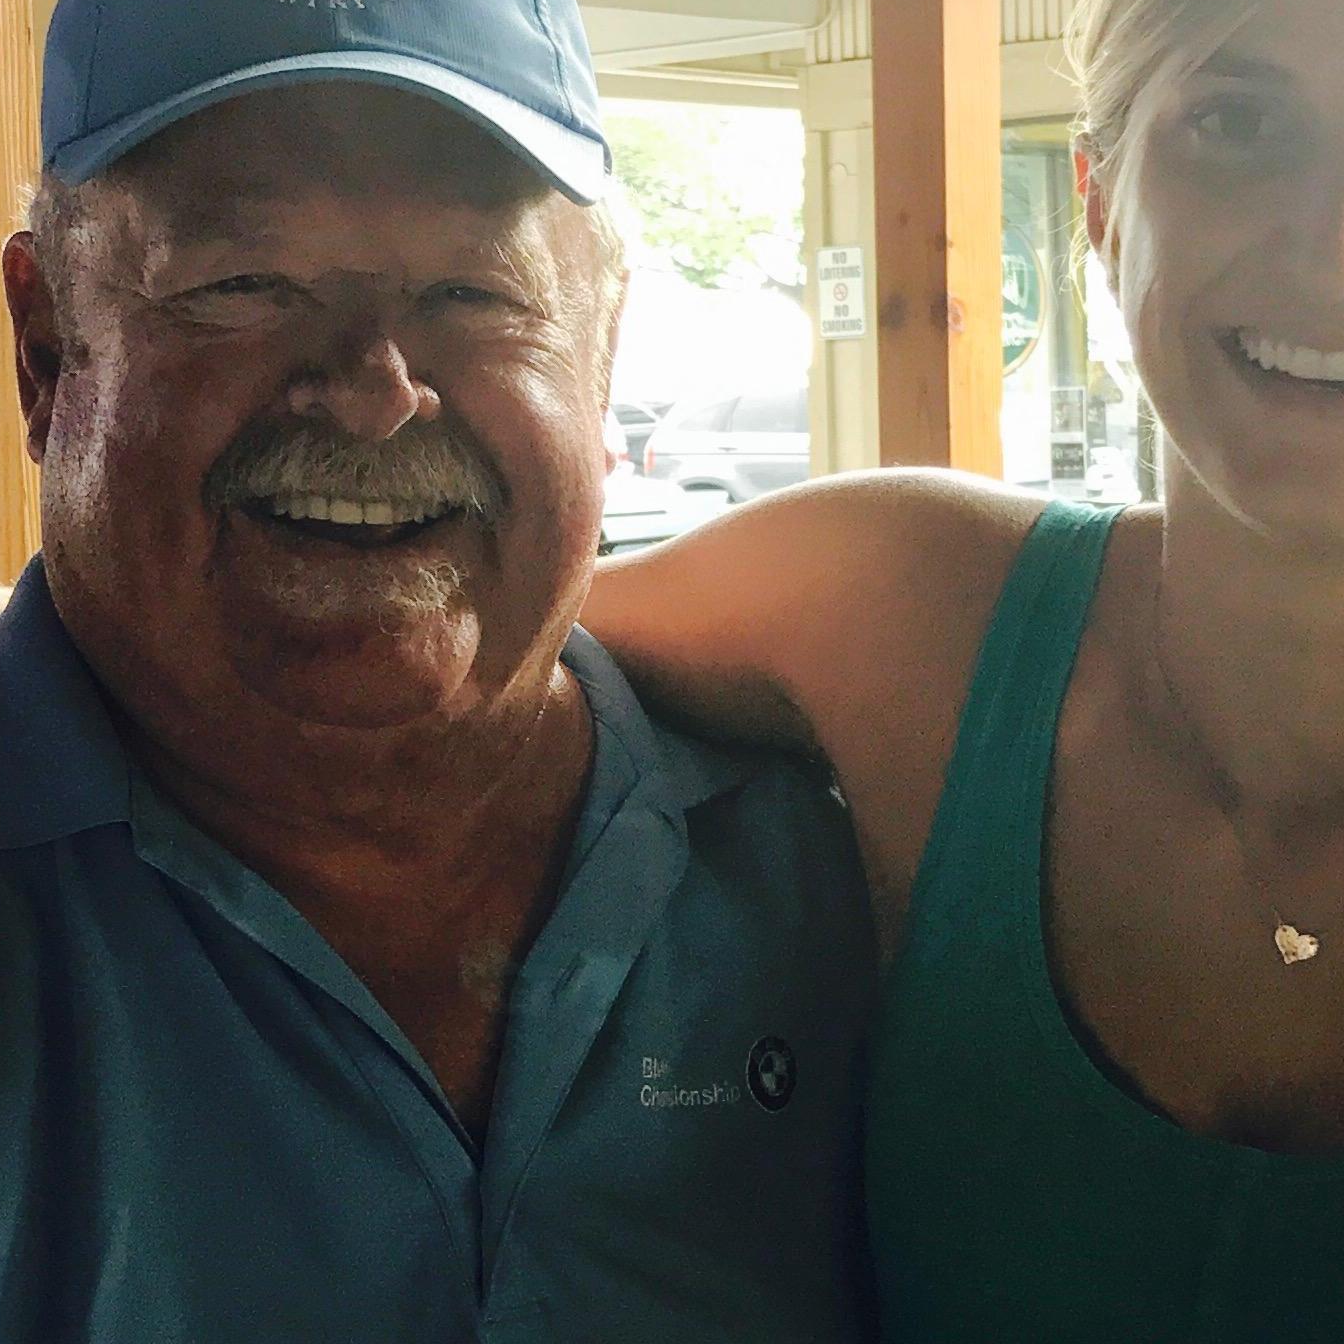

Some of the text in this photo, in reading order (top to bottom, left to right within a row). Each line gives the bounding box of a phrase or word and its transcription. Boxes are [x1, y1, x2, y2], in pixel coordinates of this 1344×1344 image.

[832, 251, 847, 264] NO
[834, 304, 849, 317] NO
[822, 318, 863, 333] SMOKING
